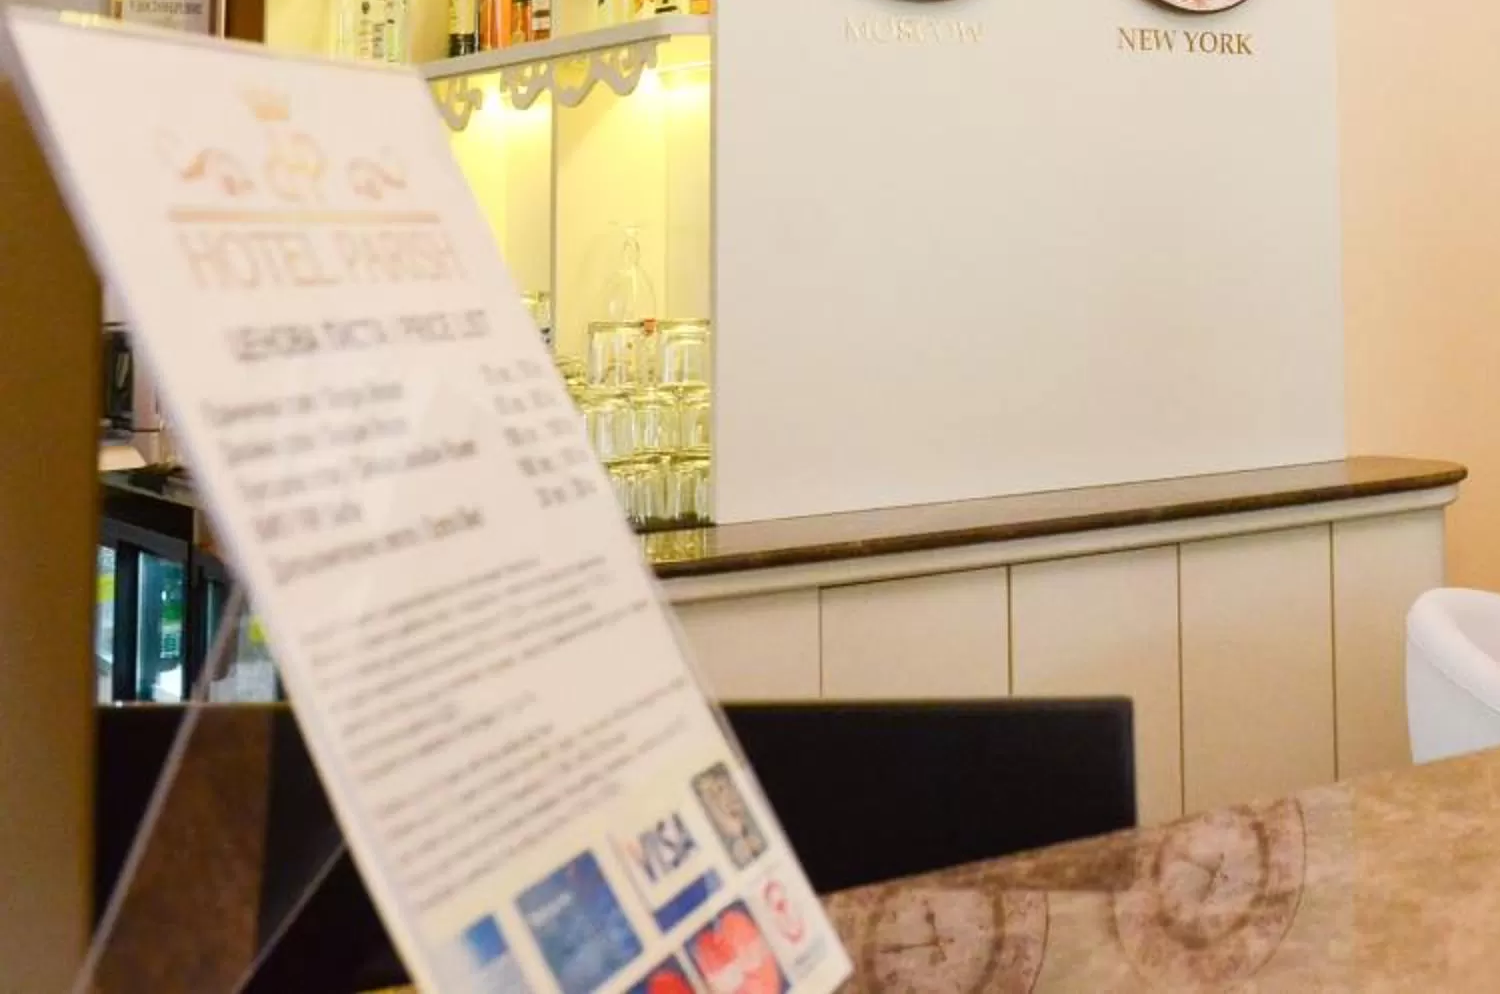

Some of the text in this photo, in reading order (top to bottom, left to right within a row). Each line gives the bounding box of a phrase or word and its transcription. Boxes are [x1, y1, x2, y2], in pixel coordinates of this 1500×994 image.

[1117, 27, 1253, 55] NEW YORK
[178, 230, 342, 288] HOTEL
